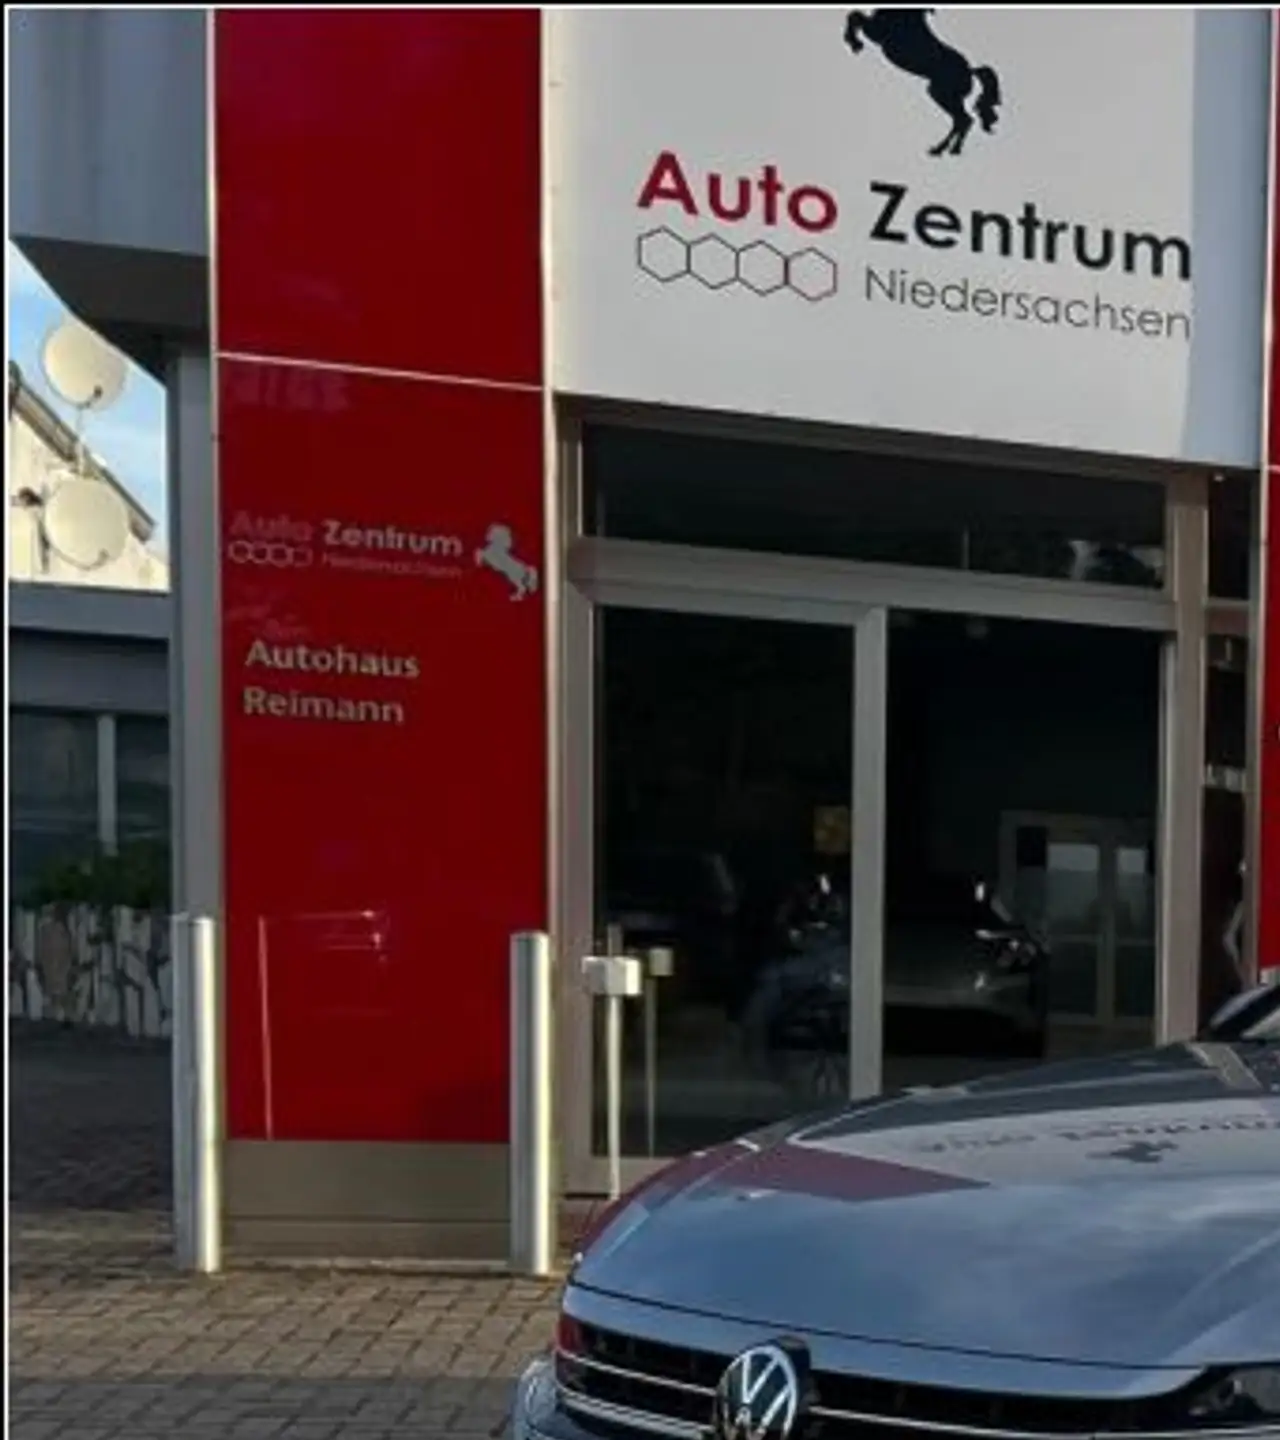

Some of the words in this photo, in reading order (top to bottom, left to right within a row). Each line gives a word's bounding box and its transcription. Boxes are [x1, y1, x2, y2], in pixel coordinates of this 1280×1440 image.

[636, 151, 838, 233] Auto
[869, 181, 1192, 280] Zentrum
[865, 267, 1191, 340] Niedersachsen
[229, 511, 314, 541] Auto
[322, 519, 464, 557] Zentrum
[245, 639, 420, 678] Autohaus
[243, 686, 405, 725] Reimann
